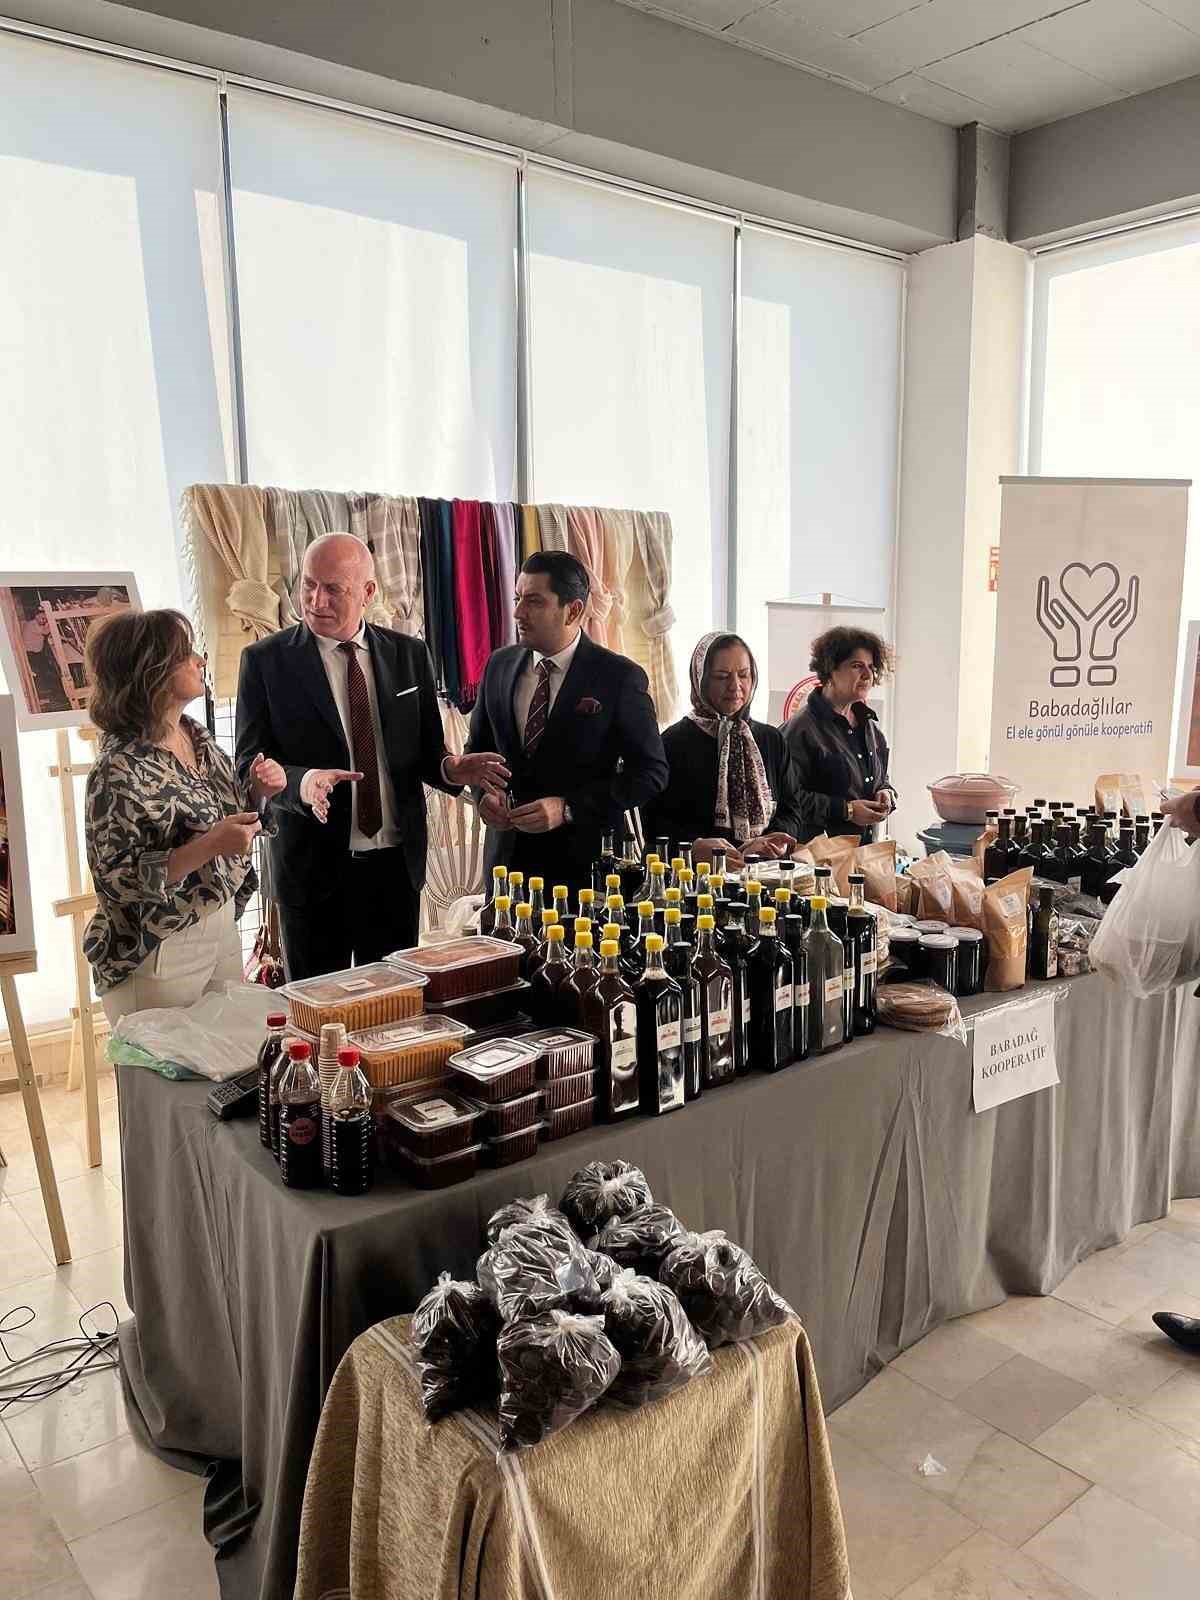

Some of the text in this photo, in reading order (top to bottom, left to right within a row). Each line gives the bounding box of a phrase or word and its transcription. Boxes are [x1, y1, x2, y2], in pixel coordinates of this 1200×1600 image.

[1029, 697, 1132, 720] Babadağlılar
[1006, 720, 1153, 741] El ele gönül gönüle kooperatifi
[990, 1027, 1038, 1057] BABADAĞ
